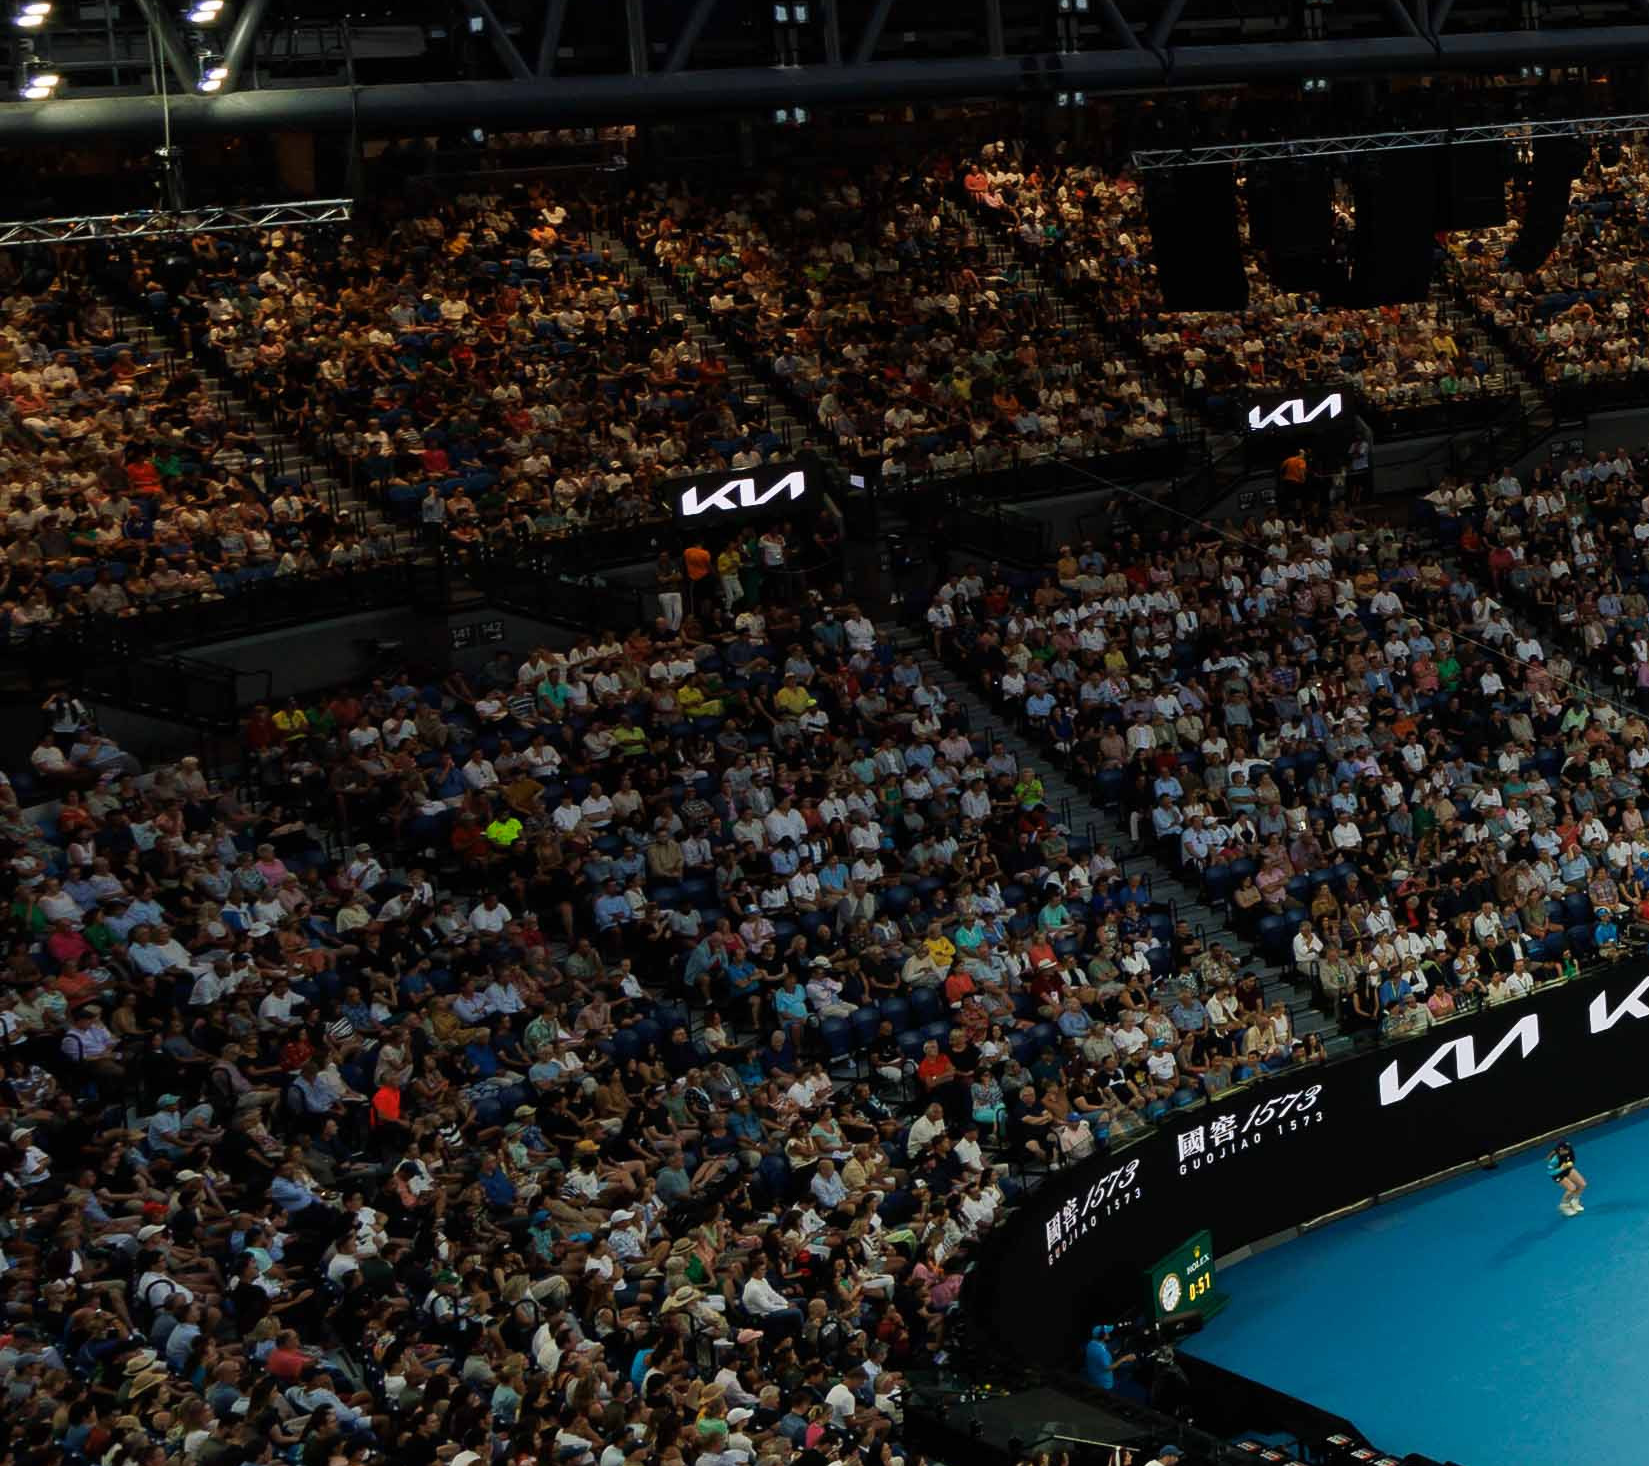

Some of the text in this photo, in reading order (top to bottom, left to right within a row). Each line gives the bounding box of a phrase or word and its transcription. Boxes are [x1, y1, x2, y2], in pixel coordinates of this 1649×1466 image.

[1249, 393, 1342, 429] KIA
[681, 470, 806, 517] KIA
[1378, 1013, 1540, 1106] KIA
[1179, 1111, 1323, 1175] GUOJIAO 1573
[1047, 1187, 1142, 1267] GUOJIAO 1573
[1186, 1253, 1211, 1276] ROLEX
[1188, 1271, 1211, 1302] 0:51
